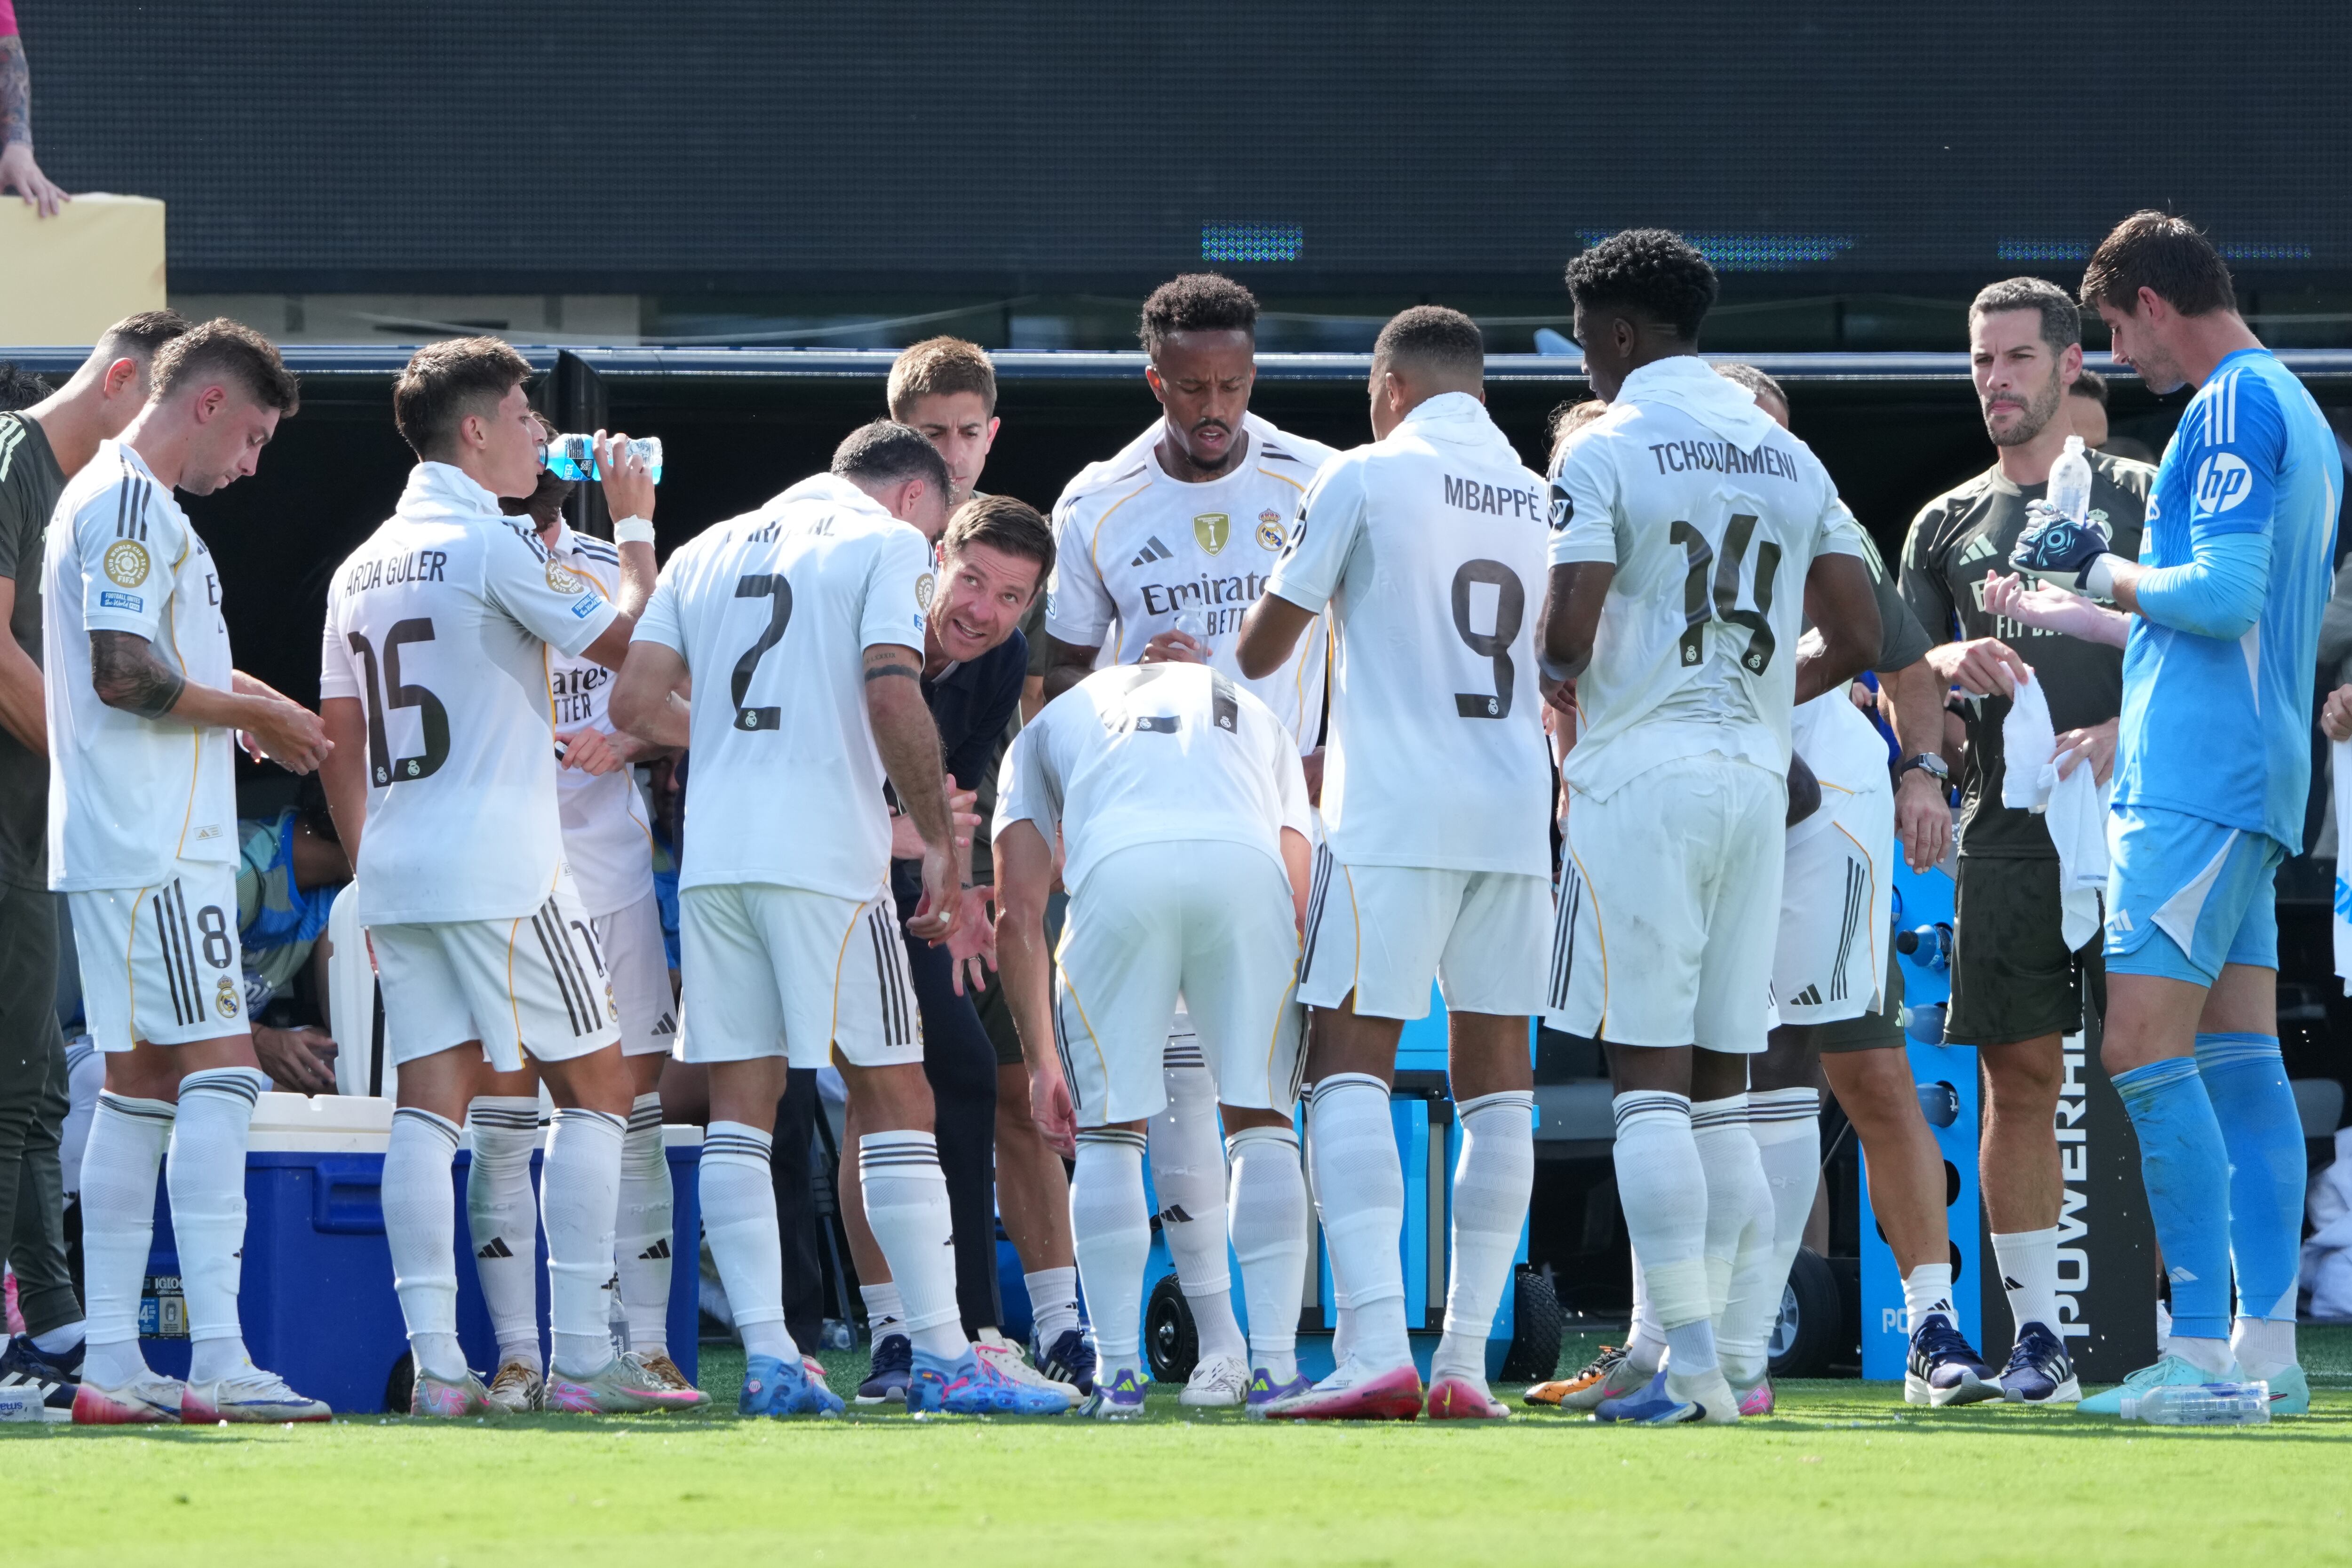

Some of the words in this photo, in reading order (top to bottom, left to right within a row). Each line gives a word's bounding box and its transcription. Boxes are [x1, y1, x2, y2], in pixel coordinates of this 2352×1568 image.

[1649, 440, 1798, 482] TCHOUAMENI
[1444, 473, 1542, 523] MBAPPÉ
[2201, 453, 2247, 514] hp
[111, 544, 131, 557] WORLD
[133, 547, 143, 557] CUP
[118, 575, 135, 584] FIFA
[136, 568, 145, 579] USA
[345, 559, 382, 598] ARDA
[386, 547, 447, 585] GÜLER
[569, 582, 582, 593] FIFA
[1140, 570, 1271, 616] Emirat
[1669, 513, 1782, 677] 14
[1207, 607, 1247, 636] BETT
[1451, 558, 1525, 719] 9
[731, 573, 793, 732] 2
[553, 666, 608, 694] ates
[347, 617, 451, 788] 15
[554, 692, 592, 724] TTER
[197, 905, 232, 969] 8
[0, 1402, 23, 1410] sma
